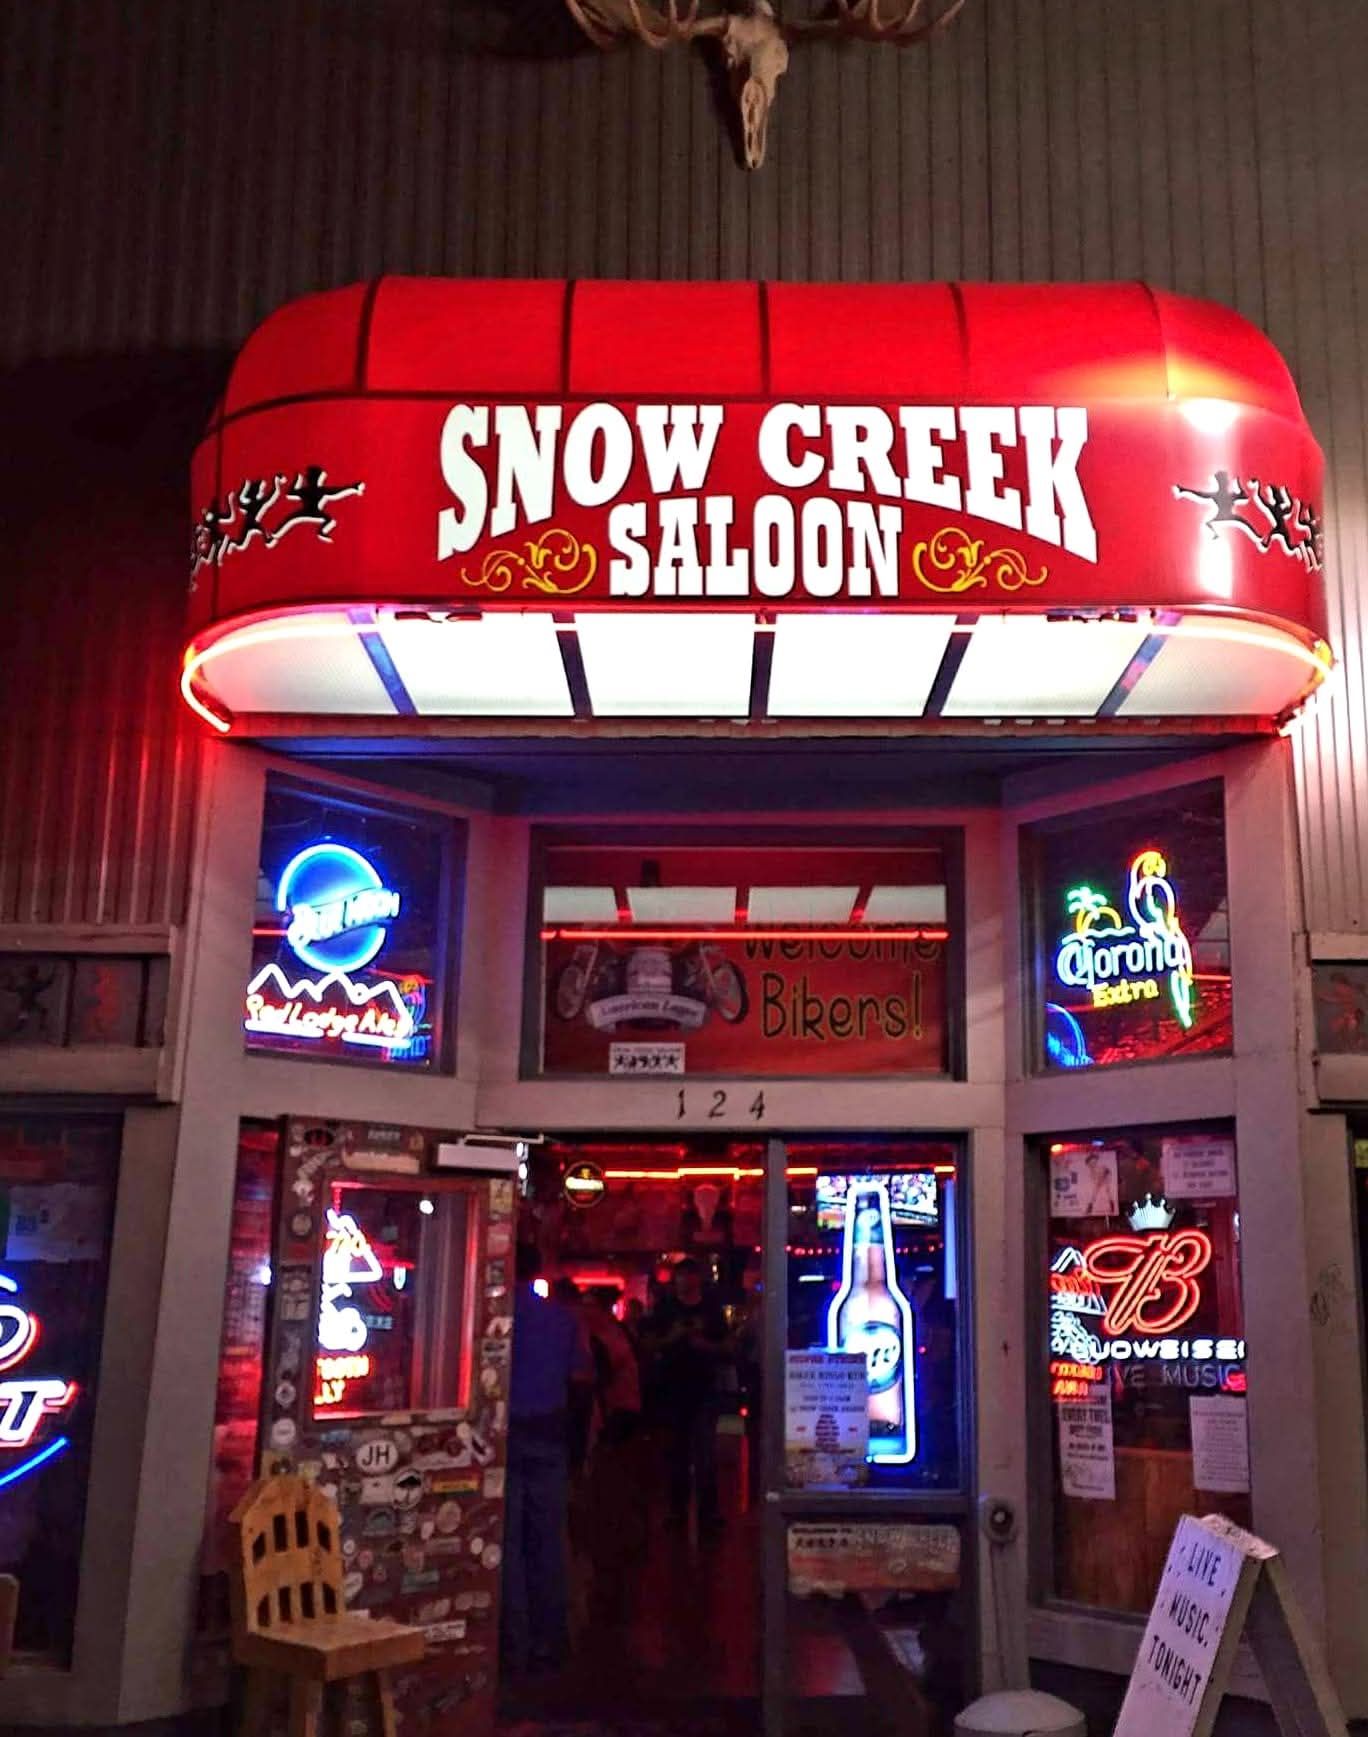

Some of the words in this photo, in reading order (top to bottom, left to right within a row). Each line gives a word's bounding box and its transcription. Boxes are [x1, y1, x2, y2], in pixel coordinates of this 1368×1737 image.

[437, 402, 724, 561] SNOW
[758, 402, 1097, 564] CREEK
[608, 495, 902, 598] SALOON
[1057, 938, 1191, 990] Corona
[761, 972, 923, 1041] Bikers!
[1092, 977, 1160, 1008] Extra
[1162, 1363, 1241, 1389] MUSIC
[361, 1444, 390, 1466] JH
[1187, 1542, 1221, 1586] LIVE
[1148, 1635, 1201, 1705] TONIGHT
